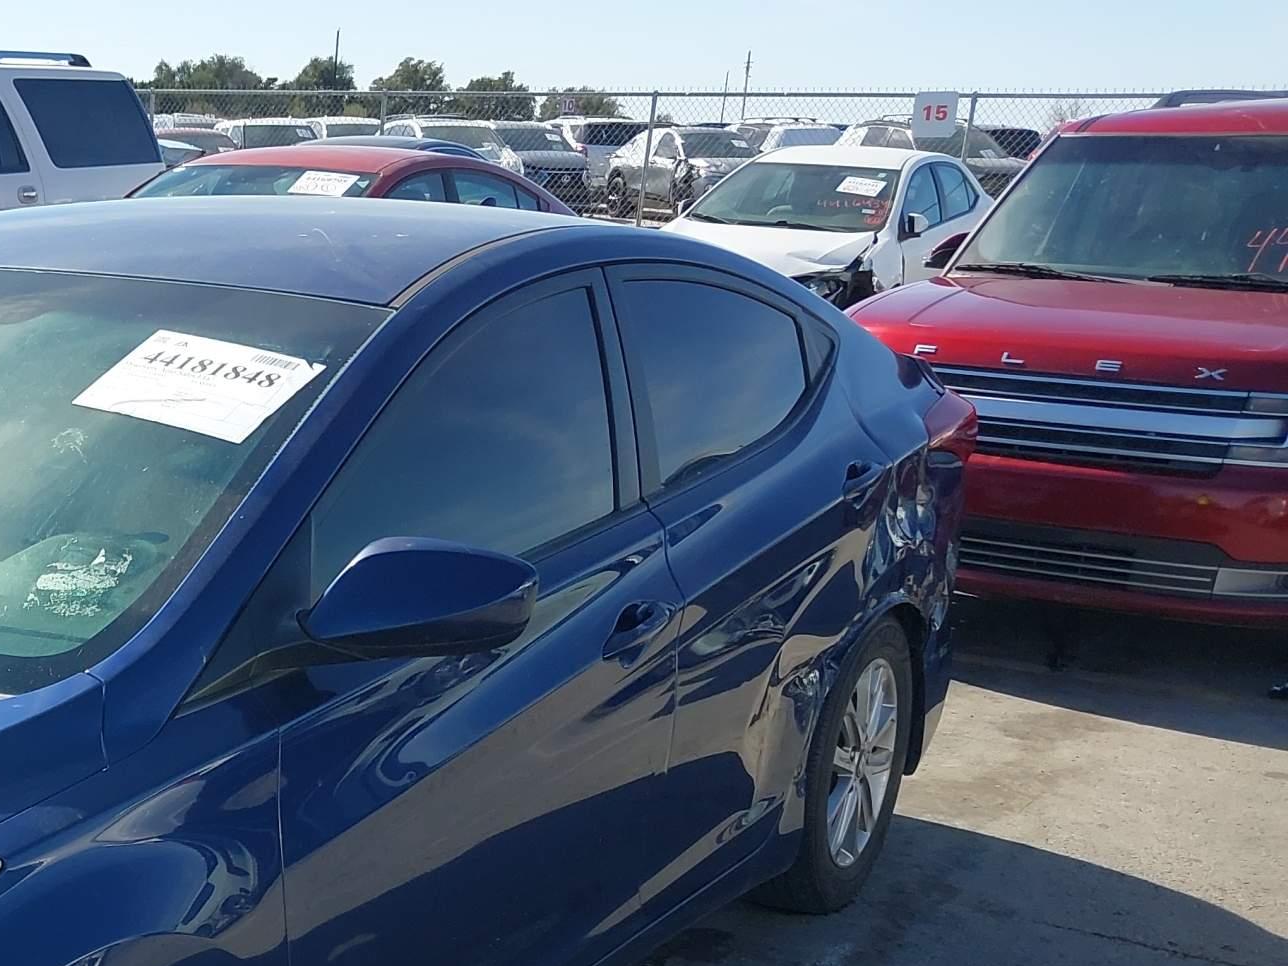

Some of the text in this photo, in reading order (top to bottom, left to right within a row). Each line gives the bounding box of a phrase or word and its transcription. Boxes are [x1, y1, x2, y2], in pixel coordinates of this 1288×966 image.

[563, 100, 574, 111] 10
[923, 105, 948, 121] 15
[143, 351, 282, 388] 44181848
[913, 344, 1228, 381] FLEX
